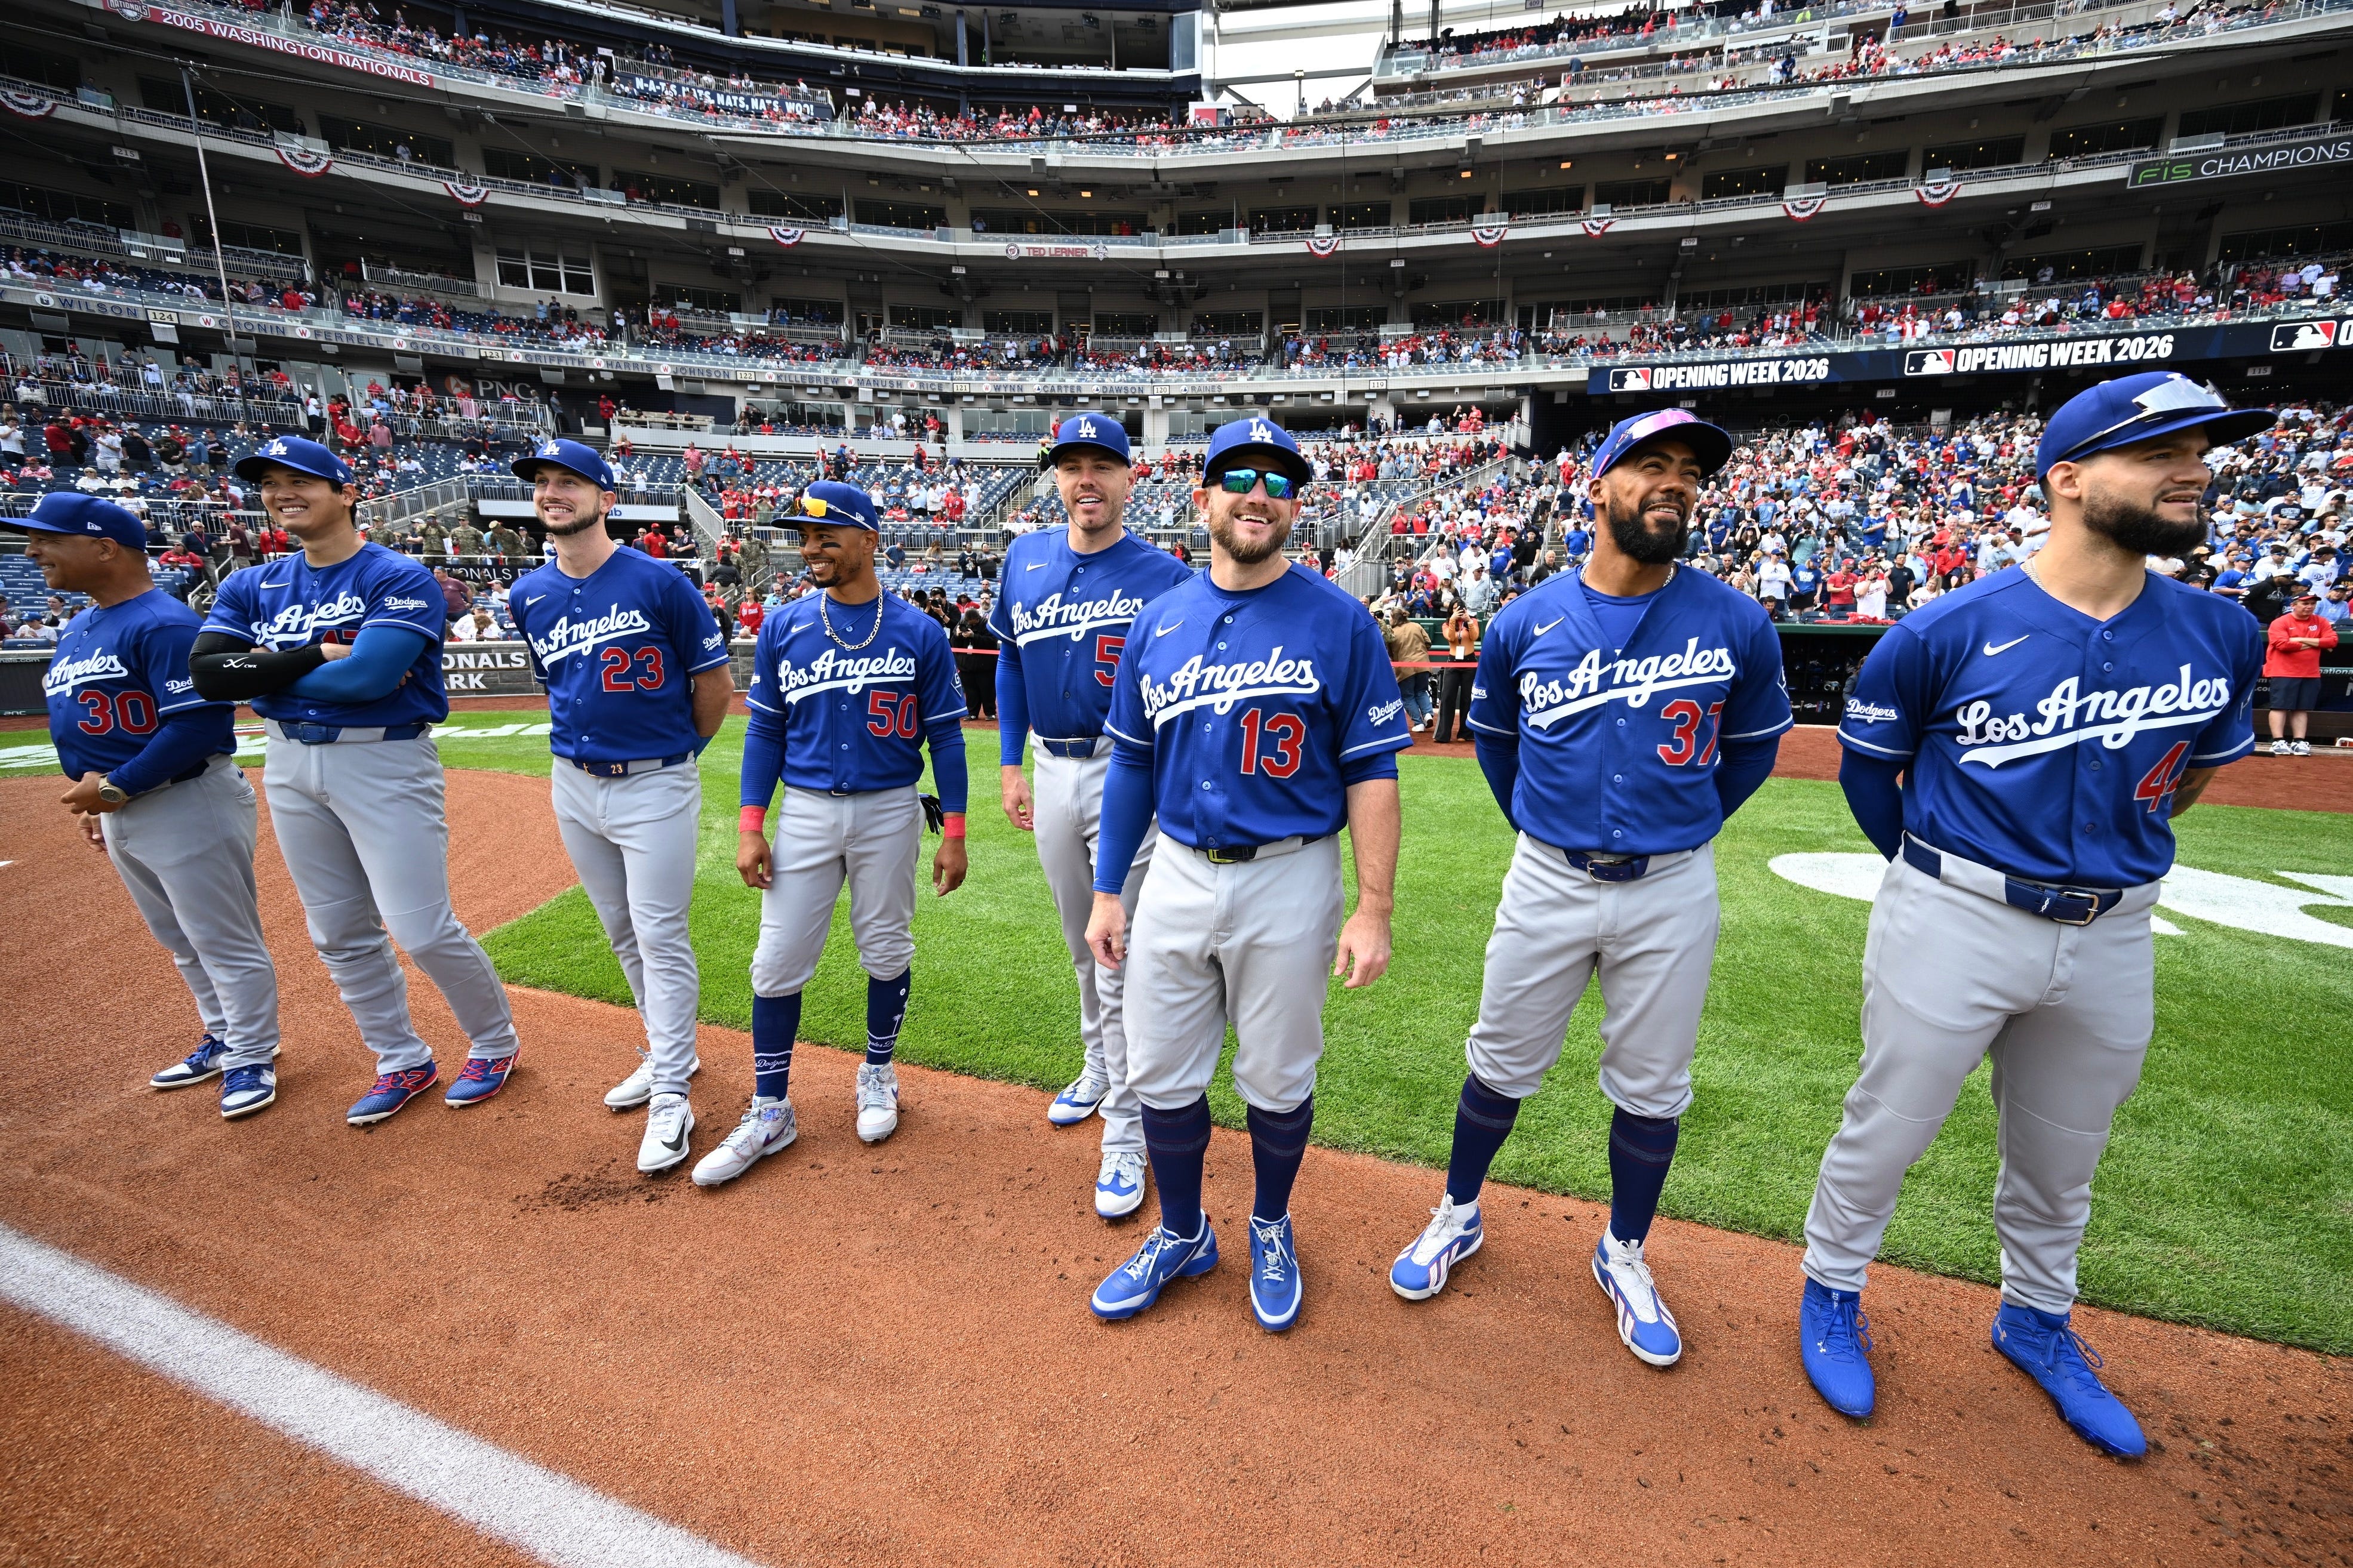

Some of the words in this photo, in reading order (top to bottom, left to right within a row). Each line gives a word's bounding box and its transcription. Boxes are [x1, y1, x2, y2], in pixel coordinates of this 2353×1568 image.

[161, 11, 205, 32] 2005
[210, 22, 334, 63] WASHINGTON
[338, 53, 430, 86] NATIONALS
[716, 93, 749, 110] NATS,
[118, 148, 135, 158] 215
[2201, 141, 2352, 176] CHAMPIONS
[1026, 247, 1045, 256] TED
[1048, 247, 1088, 257] LERNER
[59, 297, 139, 318] WILSON
[152, 311, 175, 322] 124
[219, 318, 287, 336] CRONIN
[314, 329, 384, 347] FERRELL
[410, 341, 465, 356] GOSLIN
[483, 350, 500, 359] 123
[1956, 342, 2047, 372] OPENING
[2049, 338, 2115, 365] WEEK
[2115, 335, 2173, 361] 2026
[524, 353, 585, 367] GRIFFITH
[606, 360, 653, 372] HARRIS
[673, 366, 730, 379] JOHNSON
[777, 374, 839, 385] KILLEBREW
[1653, 363, 1729, 389] OPENING
[1730, 361, 1783, 385] WEEK
[1782, 358, 1829, 381] 2026
[2252, 366, 2268, 375] 115
[478, 379, 534, 401] PNC
[857, 378, 903, 389] MANUSH
[919, 382, 943, 391] RICE
[994, 384, 1023, 393] WYNN
[1042, 384, 1082, 393] CARTER
[1102, 385, 1145, 394] DAWSON
[1191, 385, 1223, 393] RAINES
[1078, 416, 1097, 438] LA
[1249, 417, 1274, 443] LA
[269, 439, 287, 456] LA
[543, 439, 560, 456] LA
[384, 596, 428, 611] Dodgers
[1012, 600, 1034, 636] Los
[1032, 587, 1143, 642] Angeles
[548, 602, 651, 656] Angeles
[600, 645, 665, 692] 23
[777, 660, 808, 692] Los
[807, 646, 916, 695] Angeles
[1094, 634, 1126, 688] 5
[47, 647, 128, 697] Angeles
[1520, 671, 1565, 713] Los
[1564, 636, 1736, 708] Angeles
[1140, 673, 1168, 719] Los
[1167, 645, 1320, 716] Angeles
[78, 689, 159, 735] 30
[867, 689, 918, 739] 50
[1368, 697, 1403, 726] Dodgers
[1846, 698, 1898, 723] Dodgers
[1956, 700, 2032, 746] Los
[2031, 663, 2230, 749] Angeles
[1657, 698, 1726, 766] 37
[1241, 707, 1306, 779] 13
[610, 764, 623, 774] 23
[2133, 740, 2191, 813] 4
[756, 1059, 788, 1070] Dodgers
